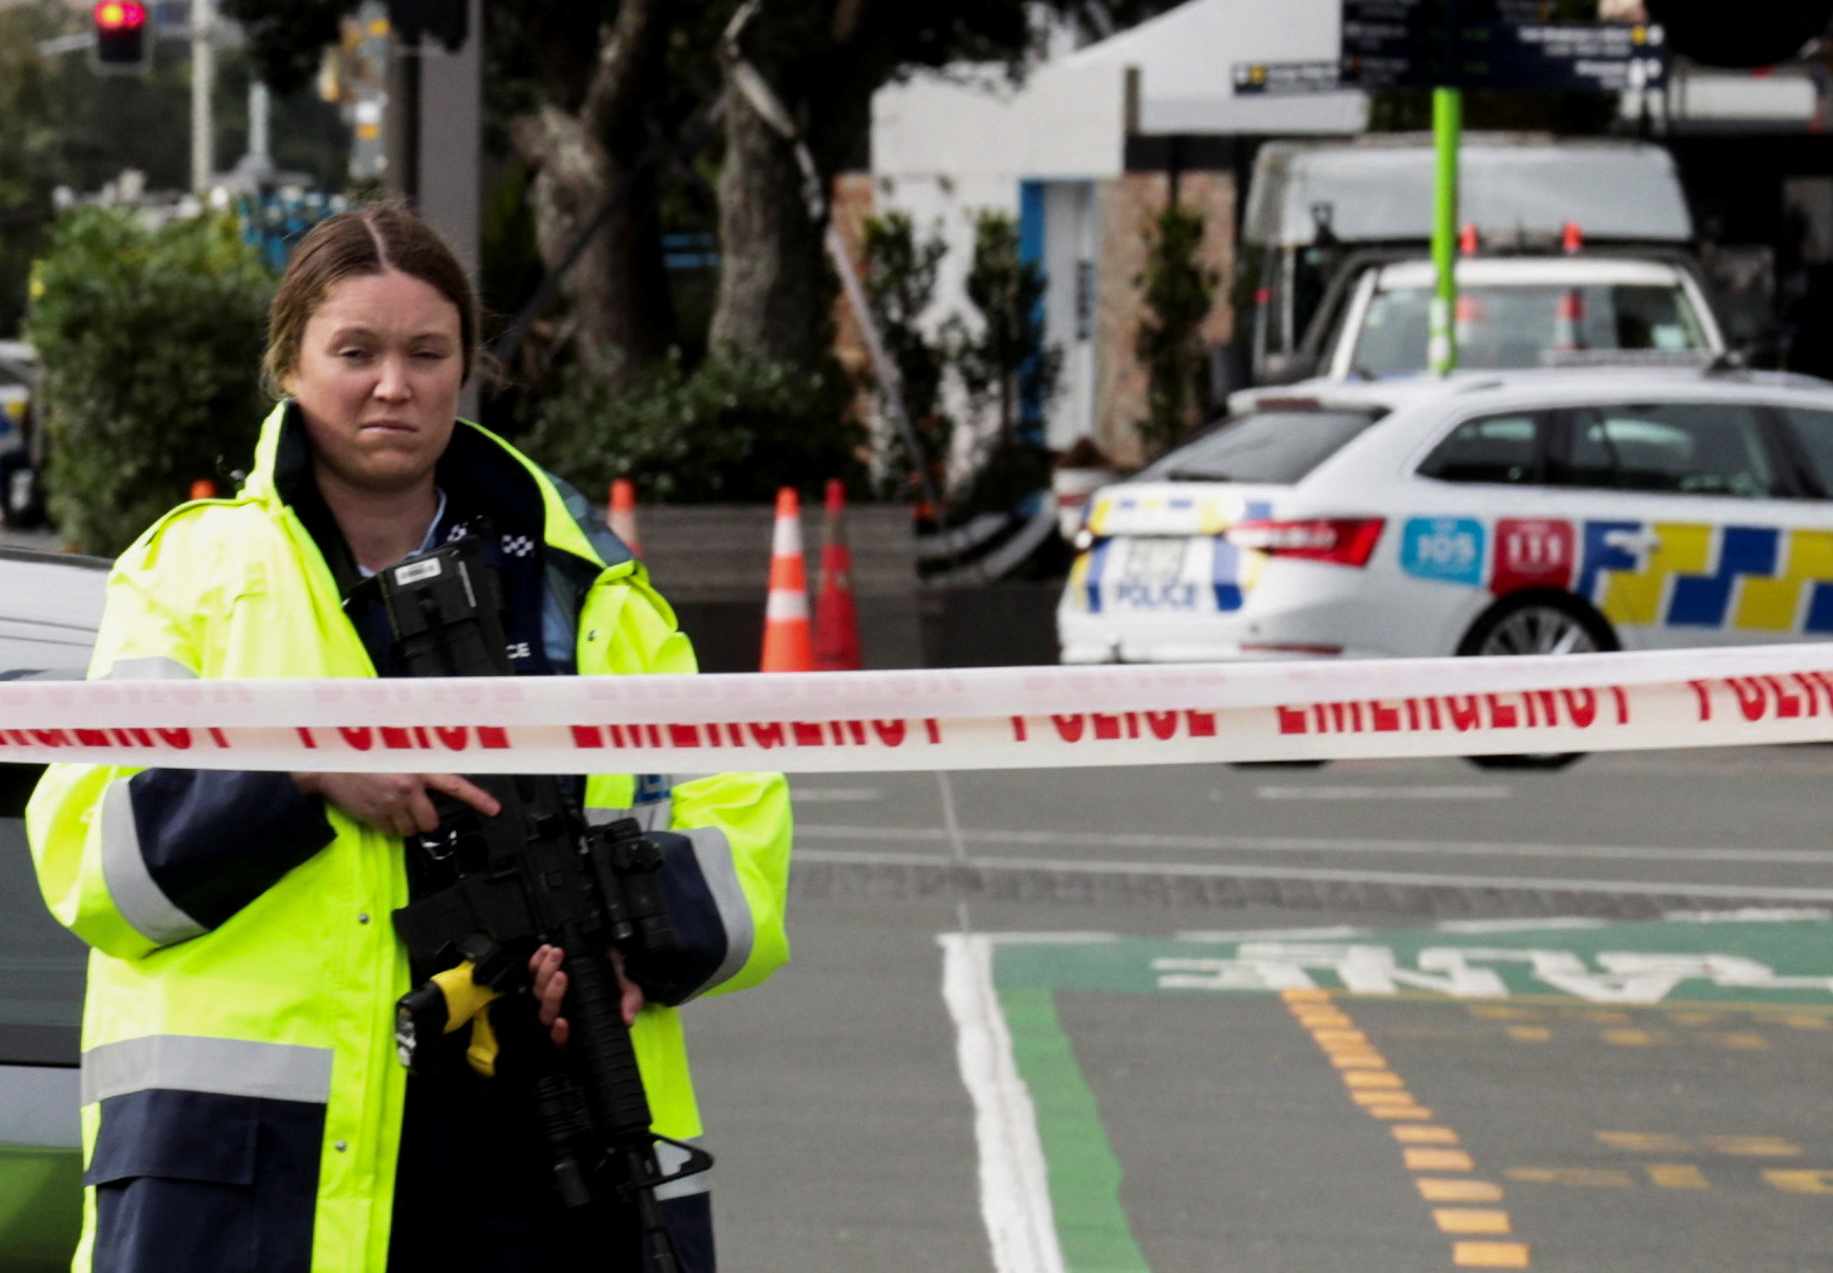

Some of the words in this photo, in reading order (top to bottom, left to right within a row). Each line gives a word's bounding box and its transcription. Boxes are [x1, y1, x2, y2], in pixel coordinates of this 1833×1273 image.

[1416, 532, 1476, 564] 105
[1506, 533, 1563, 564] 111
[1115, 581, 1198, 612] POLICE
